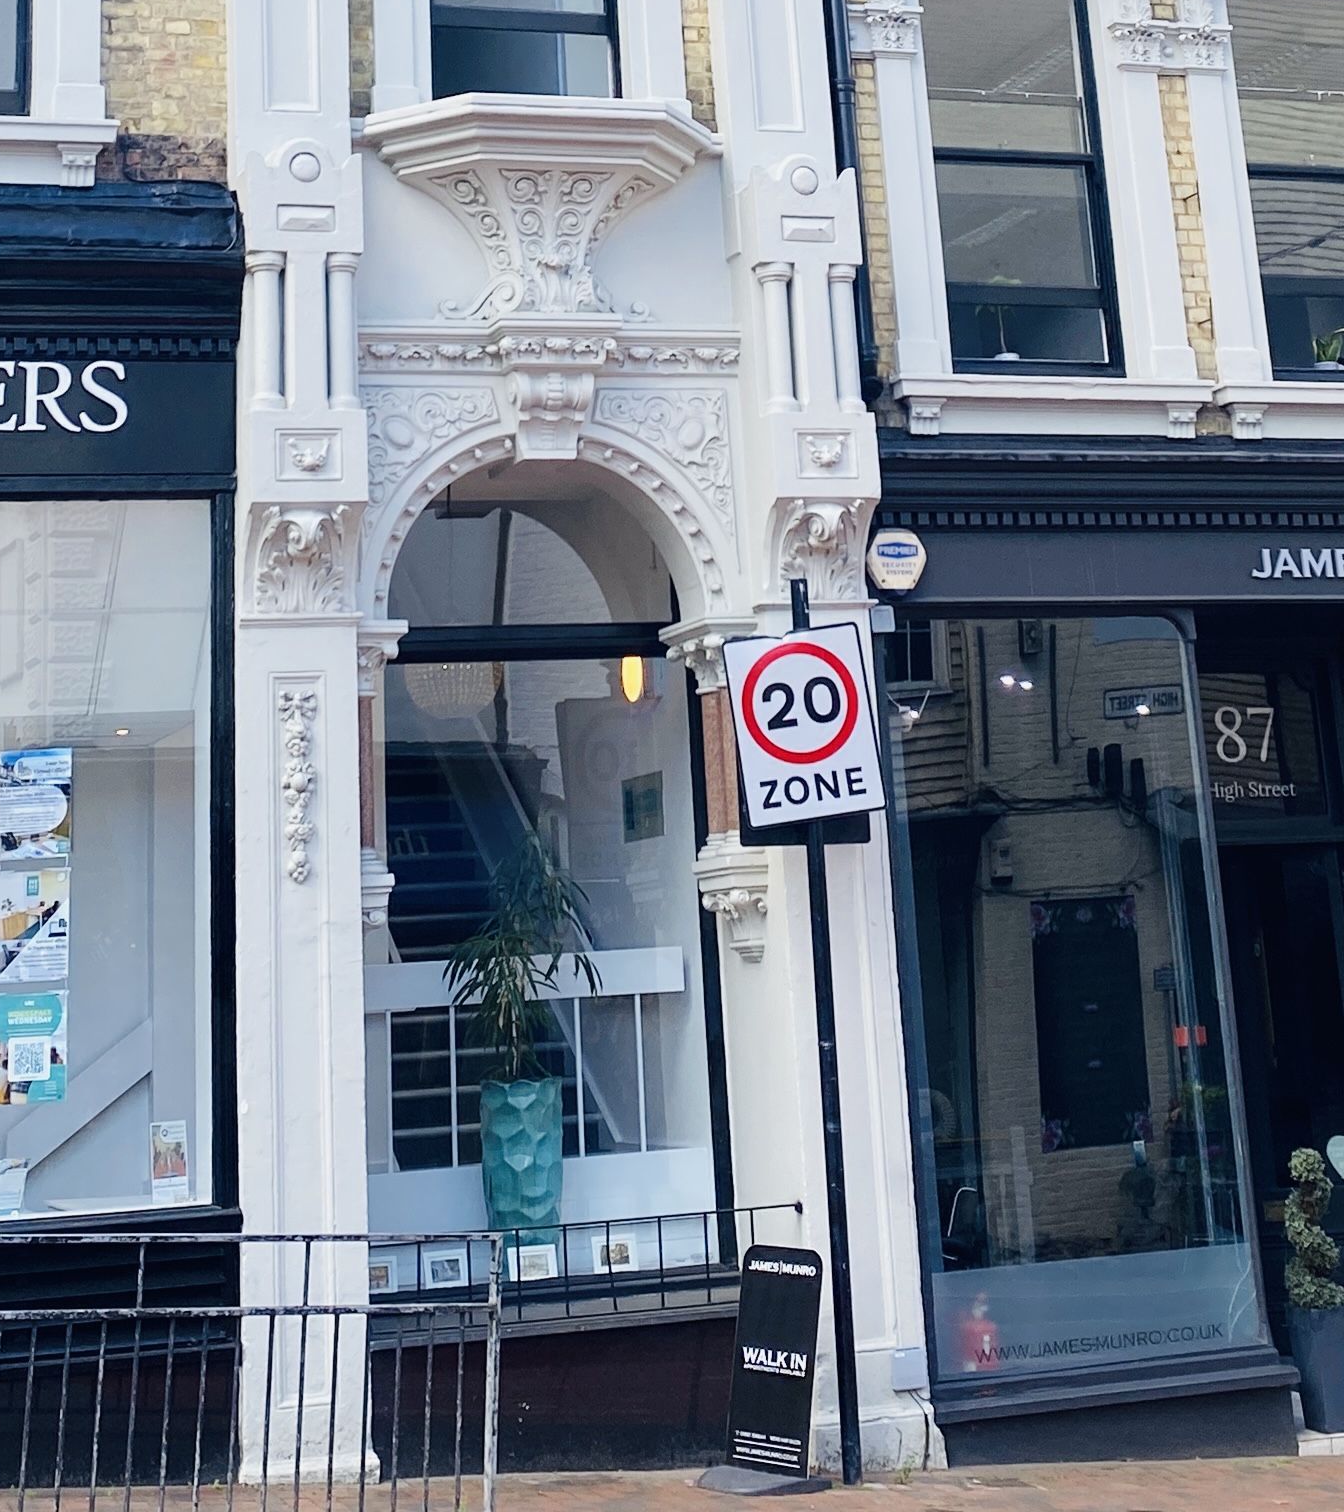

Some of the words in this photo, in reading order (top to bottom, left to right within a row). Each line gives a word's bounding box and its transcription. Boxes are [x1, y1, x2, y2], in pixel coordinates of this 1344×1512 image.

[878, 545, 917, 556] PREMIER
[761, 676, 842, 731] 20
[1214, 705, 1275, 764] 87
[760, 766, 867, 811] ZONE
[1249, 781, 1297, 798] Street
[7, 1016, 53, 1026] WEDNESDAY
[742, 1346, 788, 1368] WALK
[789, 1352, 808, 1373] IN
